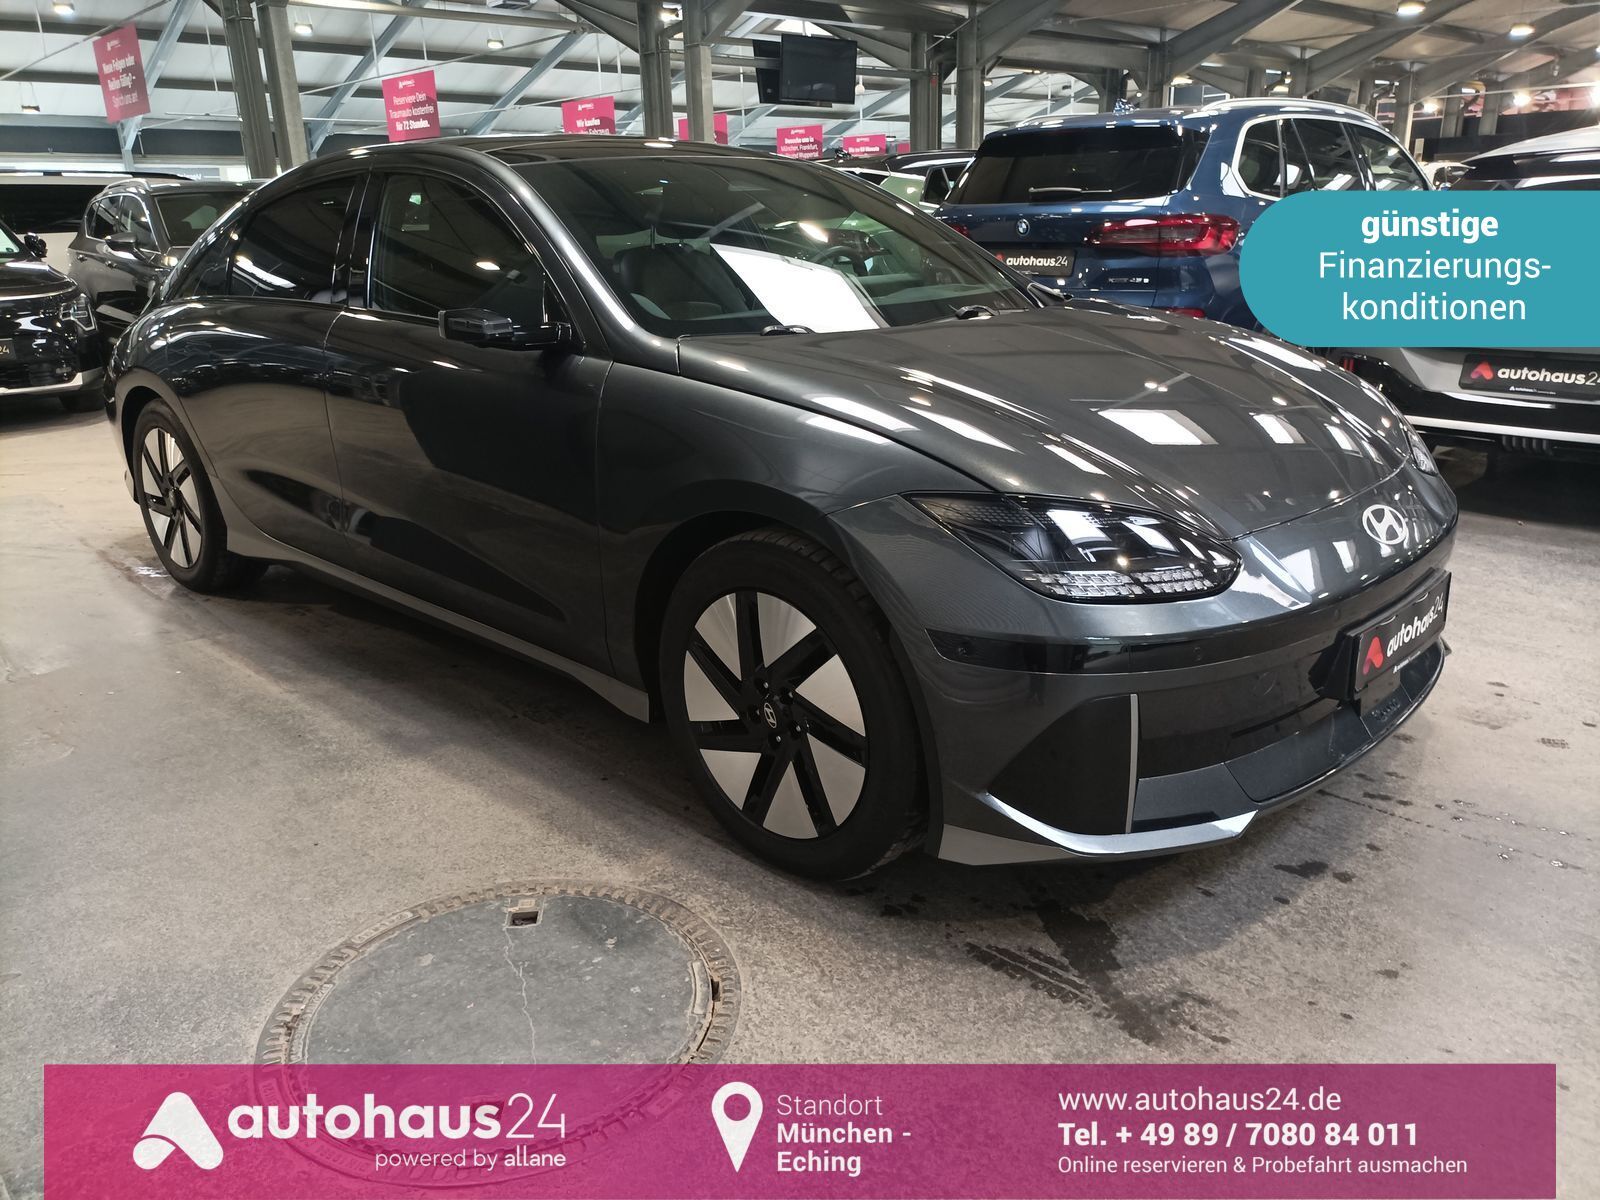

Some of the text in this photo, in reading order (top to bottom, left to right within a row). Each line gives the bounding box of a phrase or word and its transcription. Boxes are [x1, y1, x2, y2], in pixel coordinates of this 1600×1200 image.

[393, 91, 427, 105] Reserviere Dein
[389, 103, 434, 118] Traumauto kostenfrei
[395, 118, 431, 131] für 72 Stunden.
[1006, 255, 1068, 267] autohaus24
[1386, 592, 1444, 658] autohaus24
